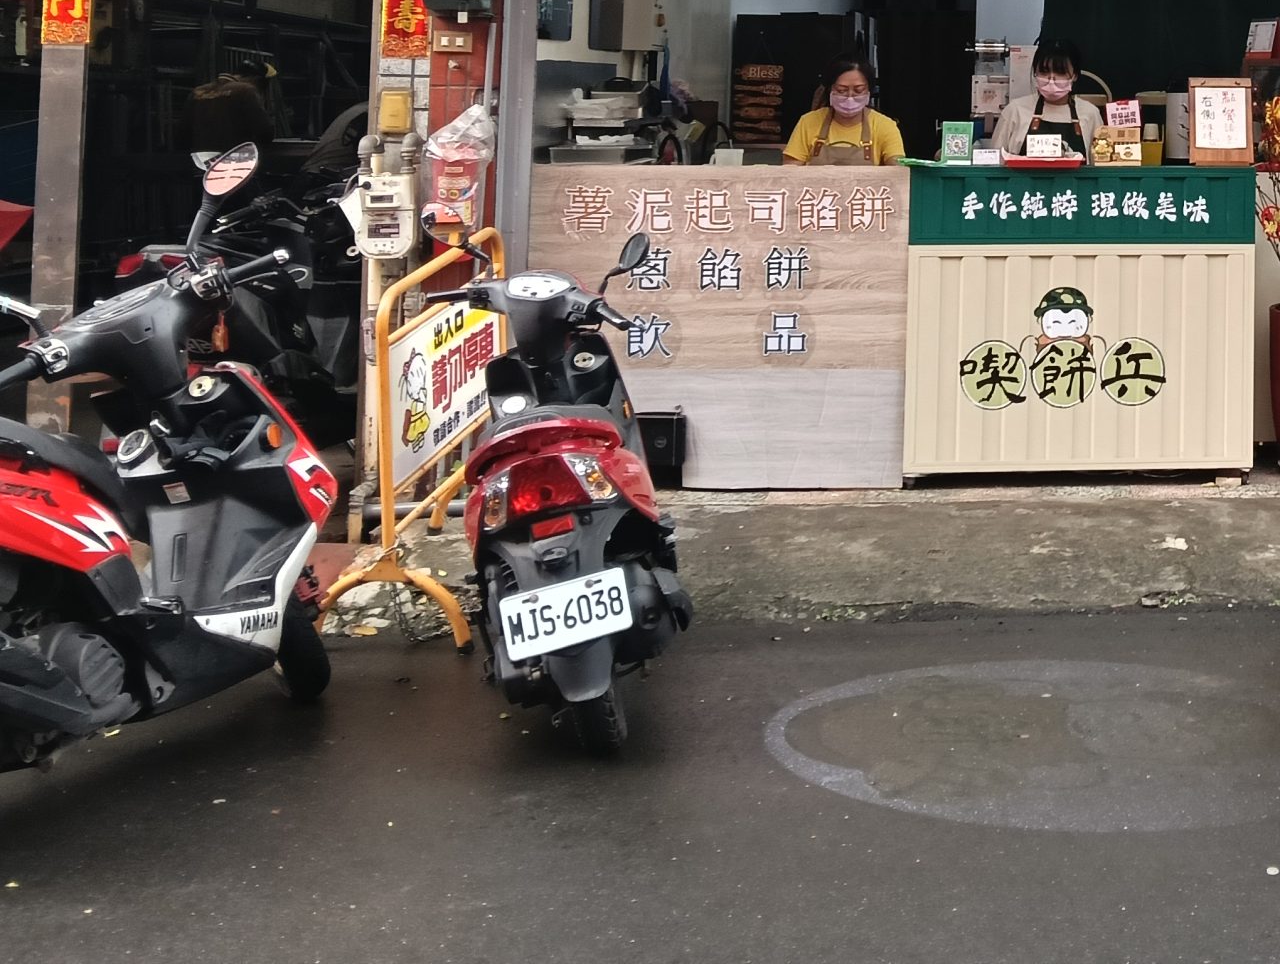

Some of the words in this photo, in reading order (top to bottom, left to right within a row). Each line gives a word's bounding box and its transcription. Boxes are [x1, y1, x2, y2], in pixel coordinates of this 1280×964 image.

[748, 66, 780, 79] Bless
[562, 185, 895, 235] 薯泥起司餡餅
[1091, 191, 1210, 224] 現做美味
[434, 309, 464, 350] 出入口
[431, 321, 494, 414] 請勿停車
[959, 341, 1167, 404] 喫餅兵
[239, 611, 279, 635] YAMAHA
